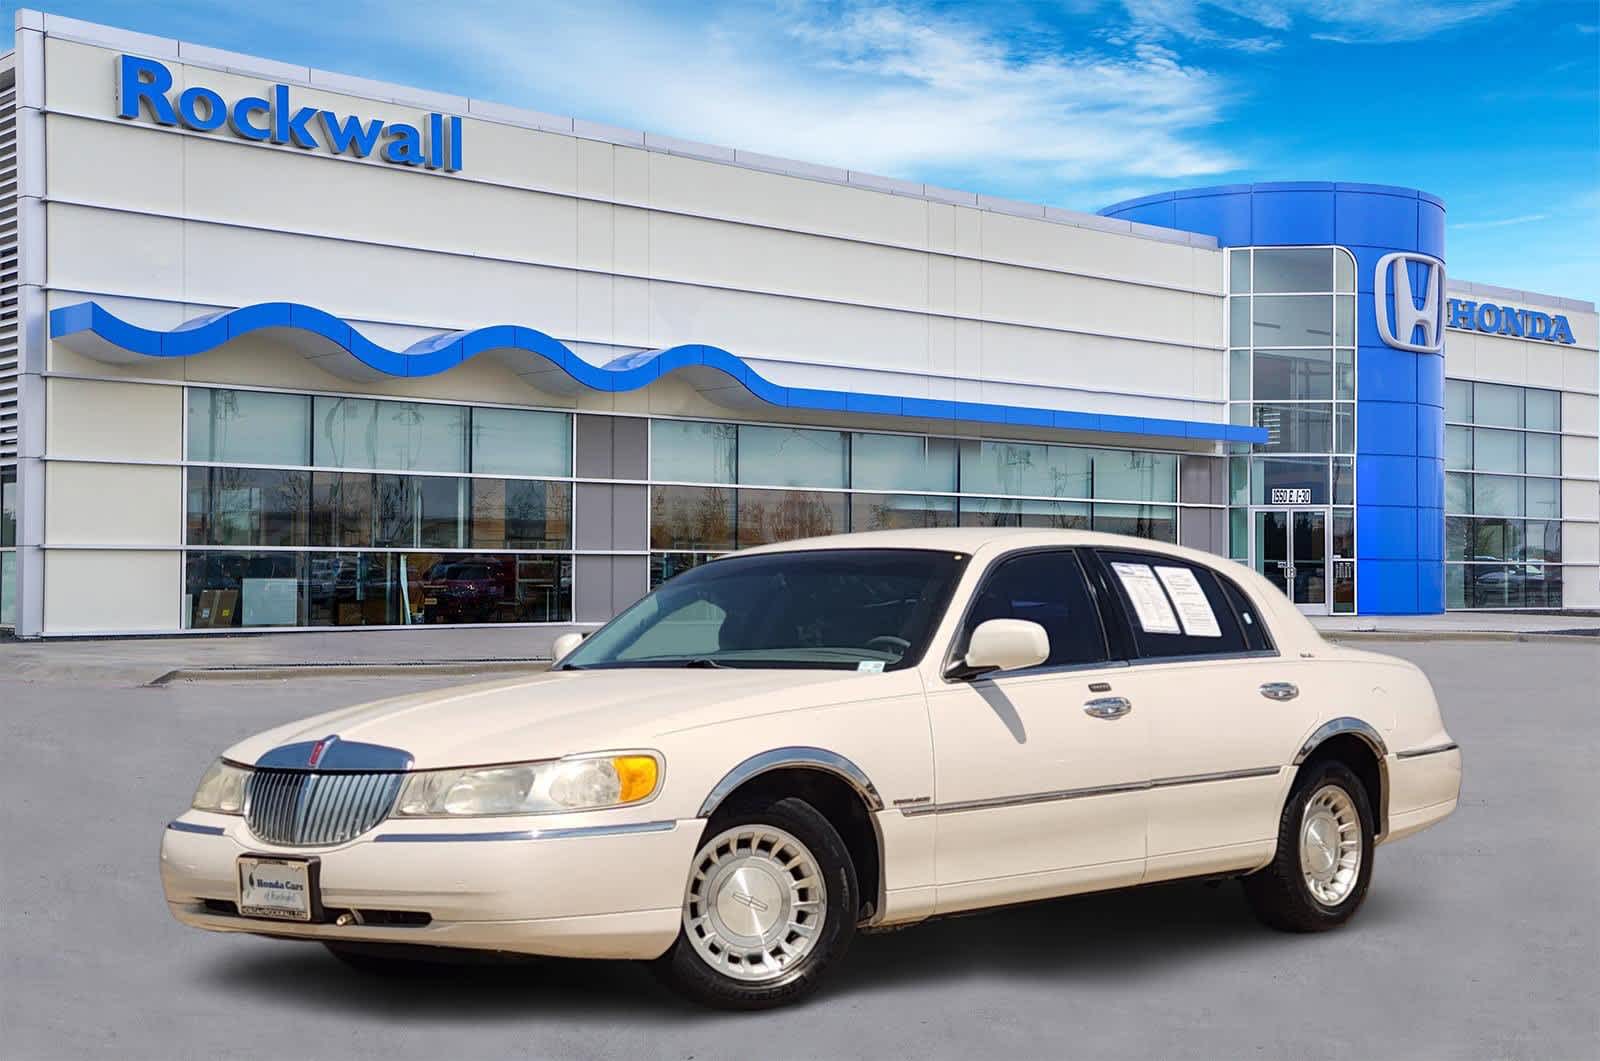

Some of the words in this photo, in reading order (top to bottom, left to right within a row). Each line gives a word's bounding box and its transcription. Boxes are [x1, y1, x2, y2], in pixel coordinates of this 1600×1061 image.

[117, 53, 463, 172] Rockwall
[1447, 298, 1576, 344] HONDA
[1273, 489, 1288, 503] 1550
[257, 879, 284, 889] Honda
[285, 881, 303, 891] Cars
